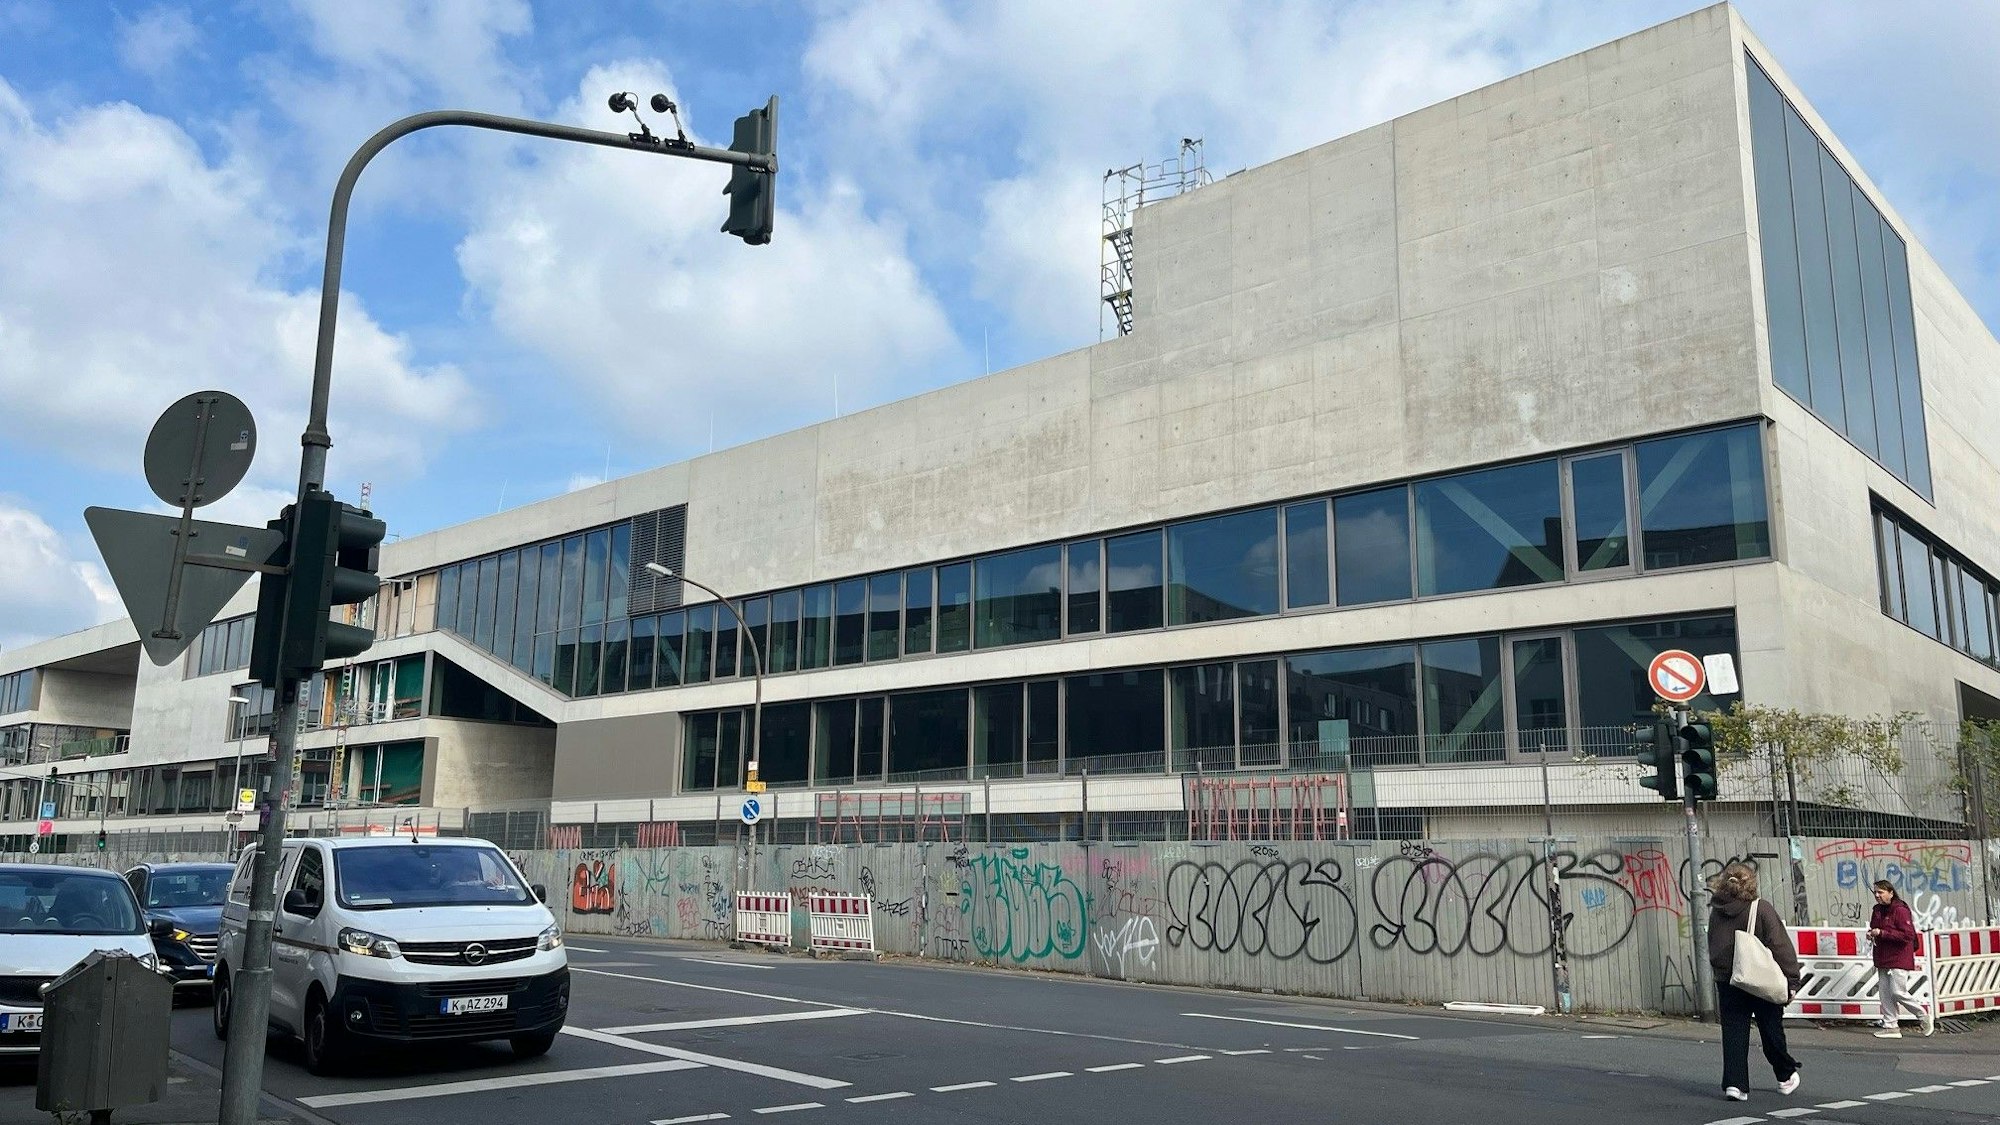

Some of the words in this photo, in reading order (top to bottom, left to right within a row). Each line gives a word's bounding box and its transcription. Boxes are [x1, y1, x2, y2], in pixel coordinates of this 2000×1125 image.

[452, 1000, 460, 1011] K
[467, 998, 481, 1009] AZ
[484, 997, 504, 1009] 294
[17, 1016, 28, 1028] K
